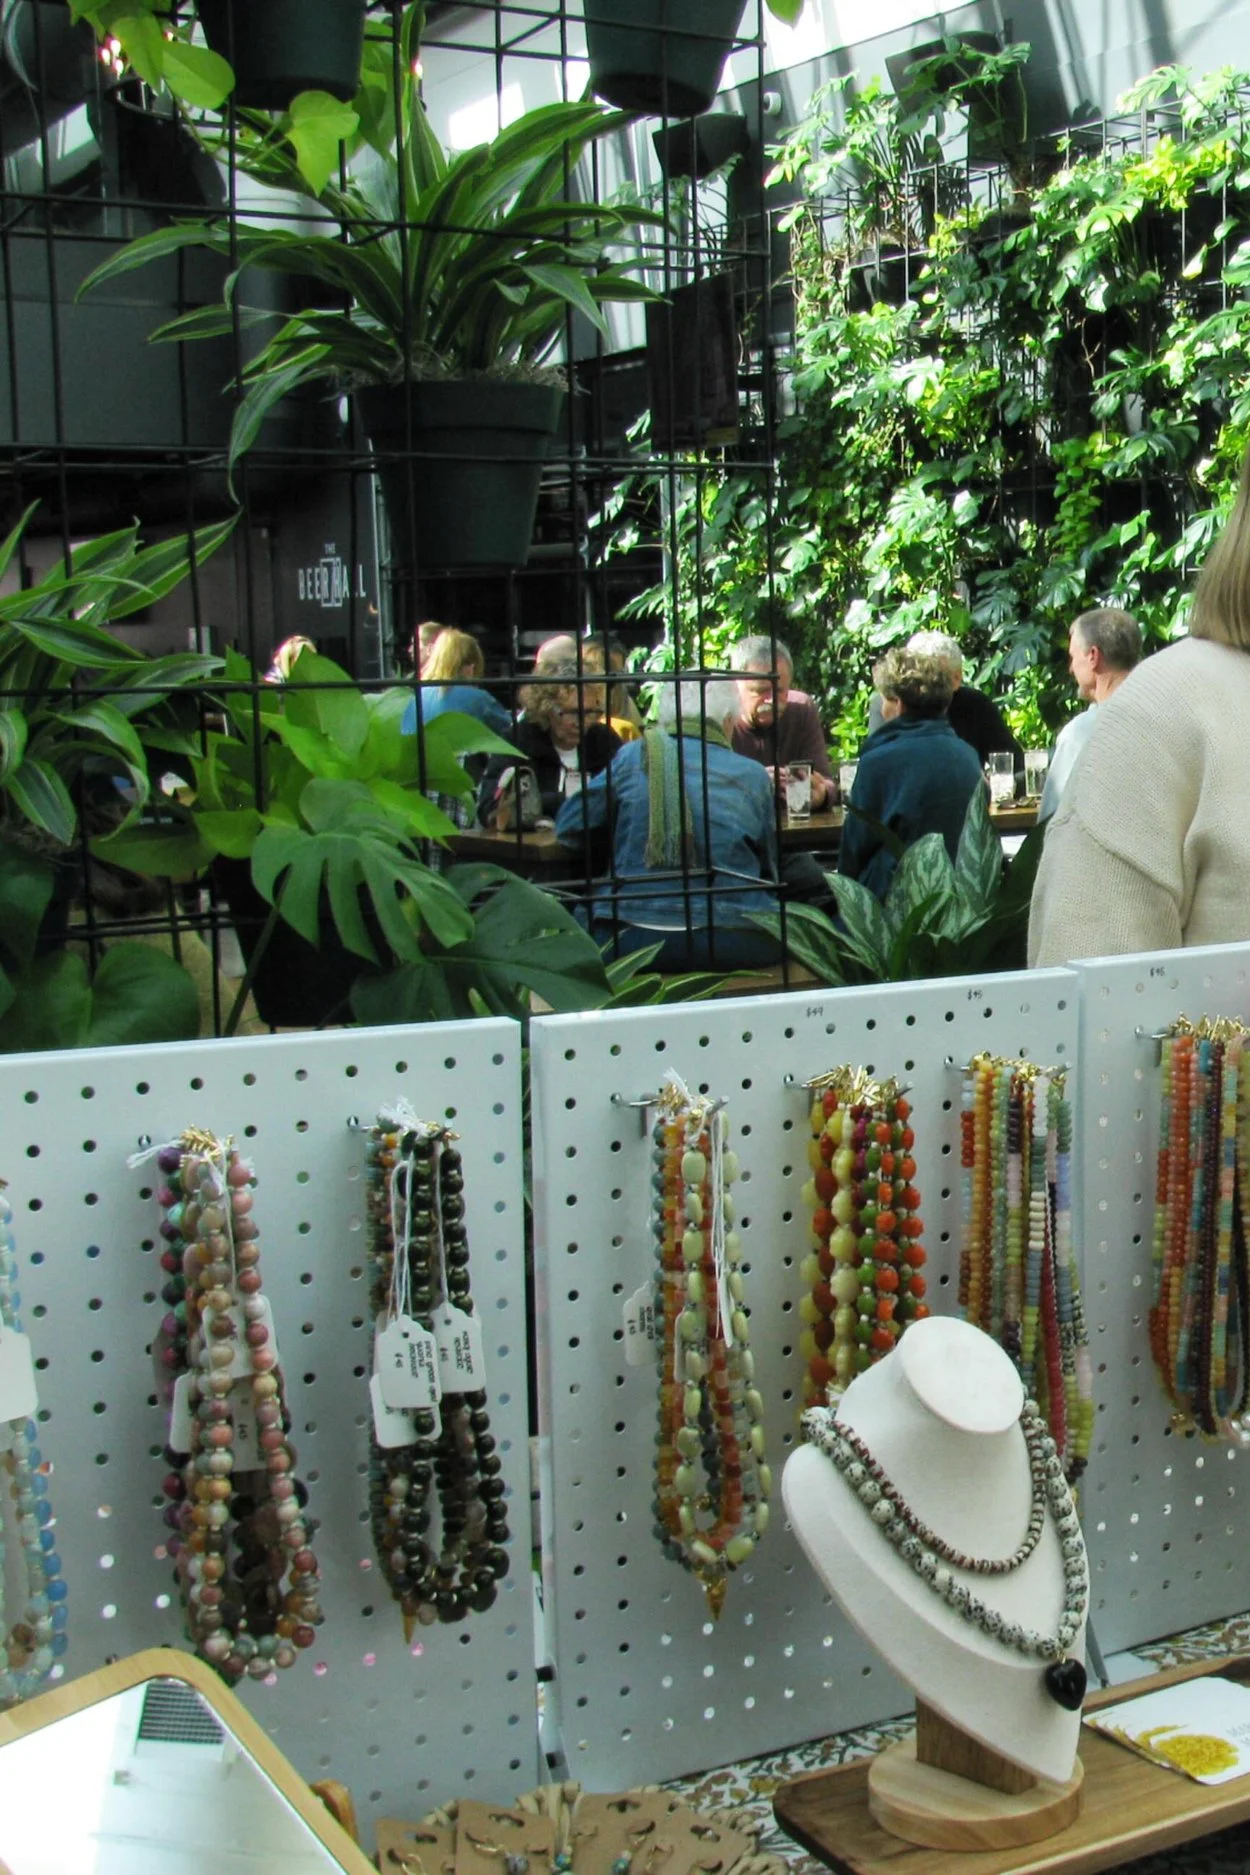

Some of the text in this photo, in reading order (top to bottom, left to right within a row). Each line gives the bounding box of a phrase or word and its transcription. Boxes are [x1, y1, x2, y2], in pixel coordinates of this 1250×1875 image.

[324, 542, 336, 555] THE
[299, 564, 366, 599] BEER HAL
